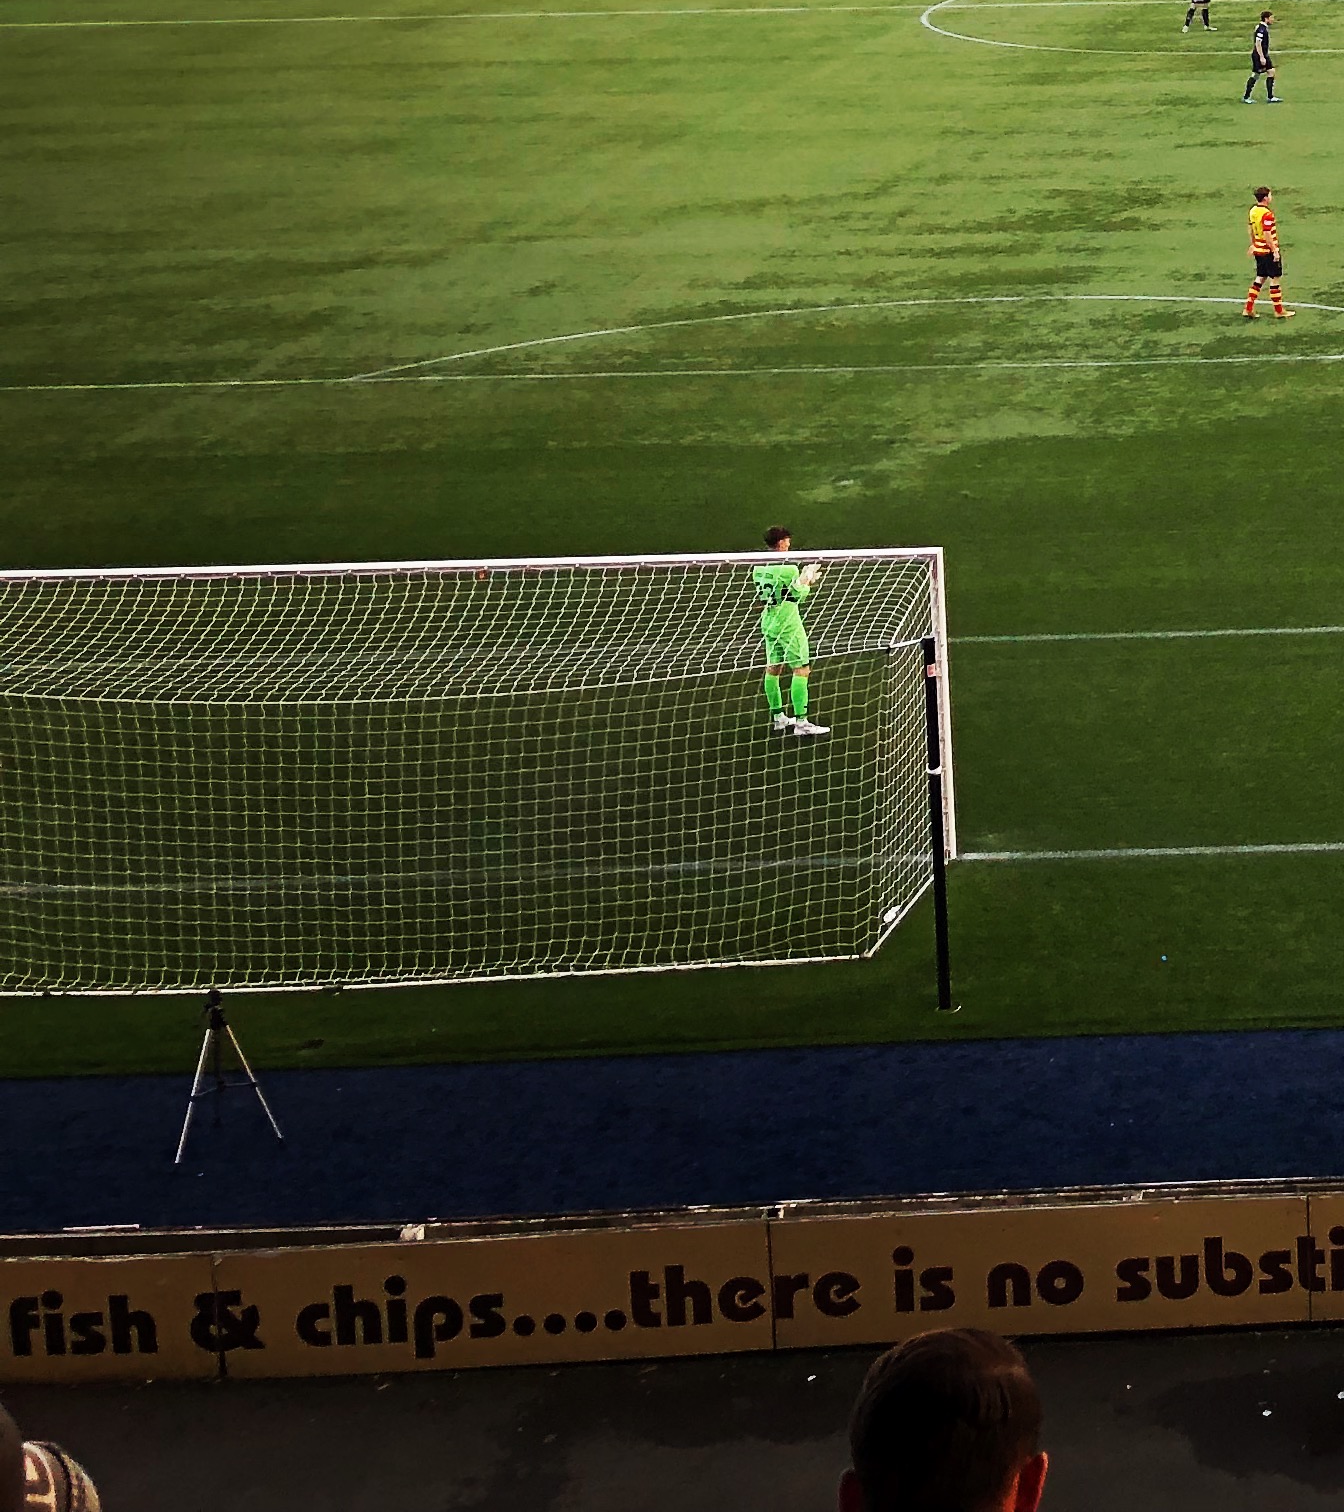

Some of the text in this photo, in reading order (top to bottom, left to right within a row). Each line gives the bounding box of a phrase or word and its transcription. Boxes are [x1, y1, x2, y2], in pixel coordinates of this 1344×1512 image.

[9, 1289, 159, 1357] fish
[189, 1290, 267, 1354] &
[892, 1245, 956, 1314] is
[987, 1258, 1085, 1309] no
